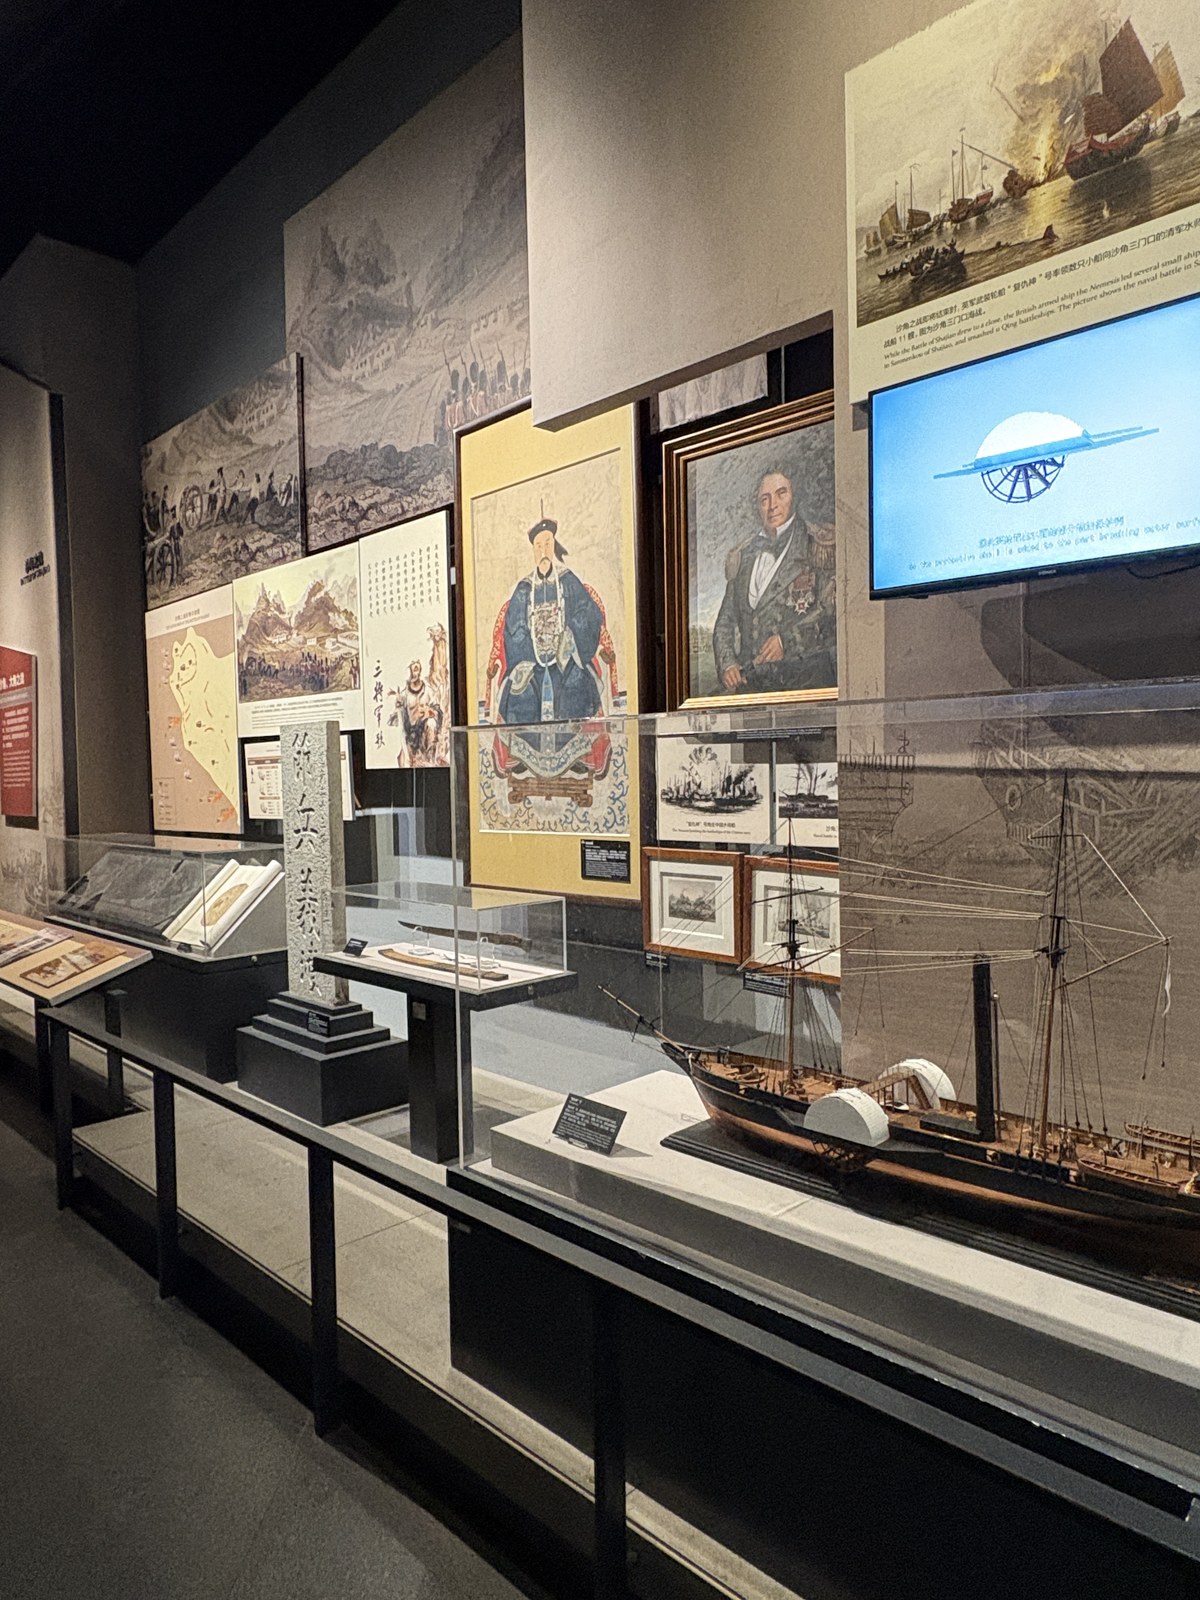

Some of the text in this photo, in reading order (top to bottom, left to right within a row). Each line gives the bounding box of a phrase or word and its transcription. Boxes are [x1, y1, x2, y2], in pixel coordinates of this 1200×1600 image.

[954, 337, 966, 346] and
[1001, 320, 1017, 332] Qing
[1058, 302, 1072, 312] The
[1073, 293, 1097, 308] picture
[1099, 286, 1122, 299] shows
[1123, 280, 1136, 291] the
[1137, 273, 1158, 286] naval
[1160, 265, 1182, 279] battle
[1004, 311, 1014, 321] the
[1016, 304, 1037, 317] British
[1038, 296, 1059, 310] armed
[1061, 291, 1075, 303] ship
[1077, 286, 1088, 297] the
[1090, 276, 1120, 292] Nemesis
[1121, 272, 1132, 281] led
[1133, 262, 1160, 277] several
[1161, 255, 1182, 268] small
